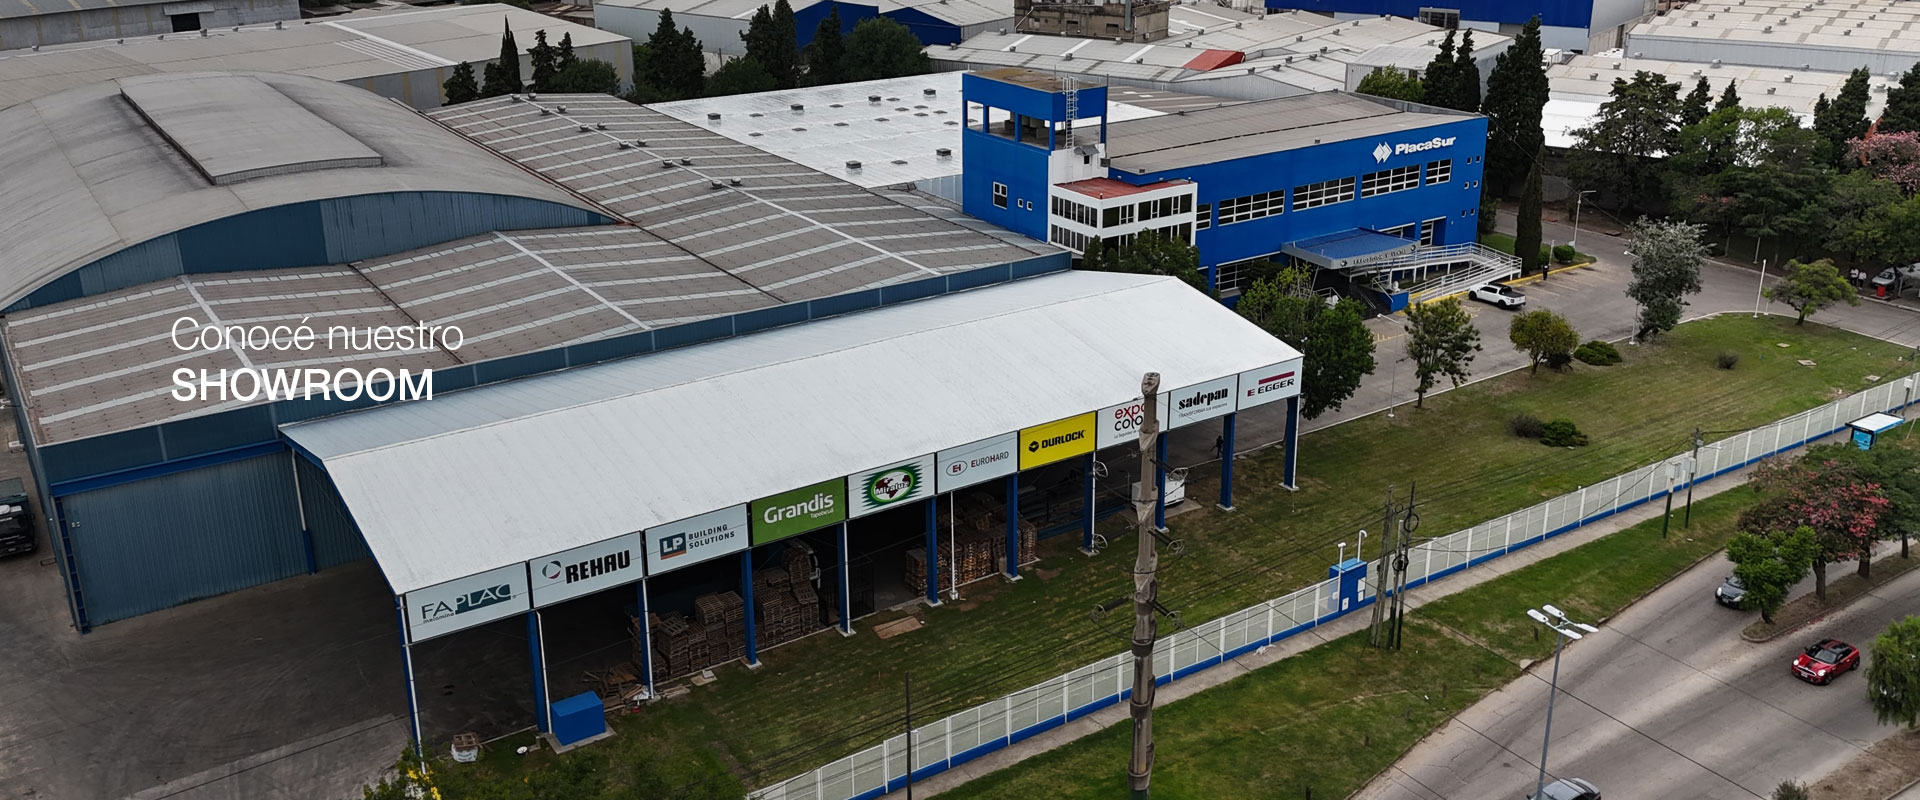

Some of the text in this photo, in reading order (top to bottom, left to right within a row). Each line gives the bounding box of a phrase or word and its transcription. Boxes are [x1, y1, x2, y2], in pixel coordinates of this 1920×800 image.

[1395, 136, 1456, 155] PlacaSur
[1257, 378, 1295, 394] EGGER
[1178, 388, 1228, 410] sadepan
[1114, 415, 1144, 431] colo
[1041, 430, 1085, 449] DURLOCK
[971, 451, 1009, 468] EUROHARD
[764, 493, 834, 524] Grandis
[688, 524, 728, 540] BUILDING
[689, 531, 735, 549] SOLUTIONS
[662, 536, 684, 553] LP
[565, 550, 630, 584] REHAU
[421, 583, 512, 619] FAPLAC
